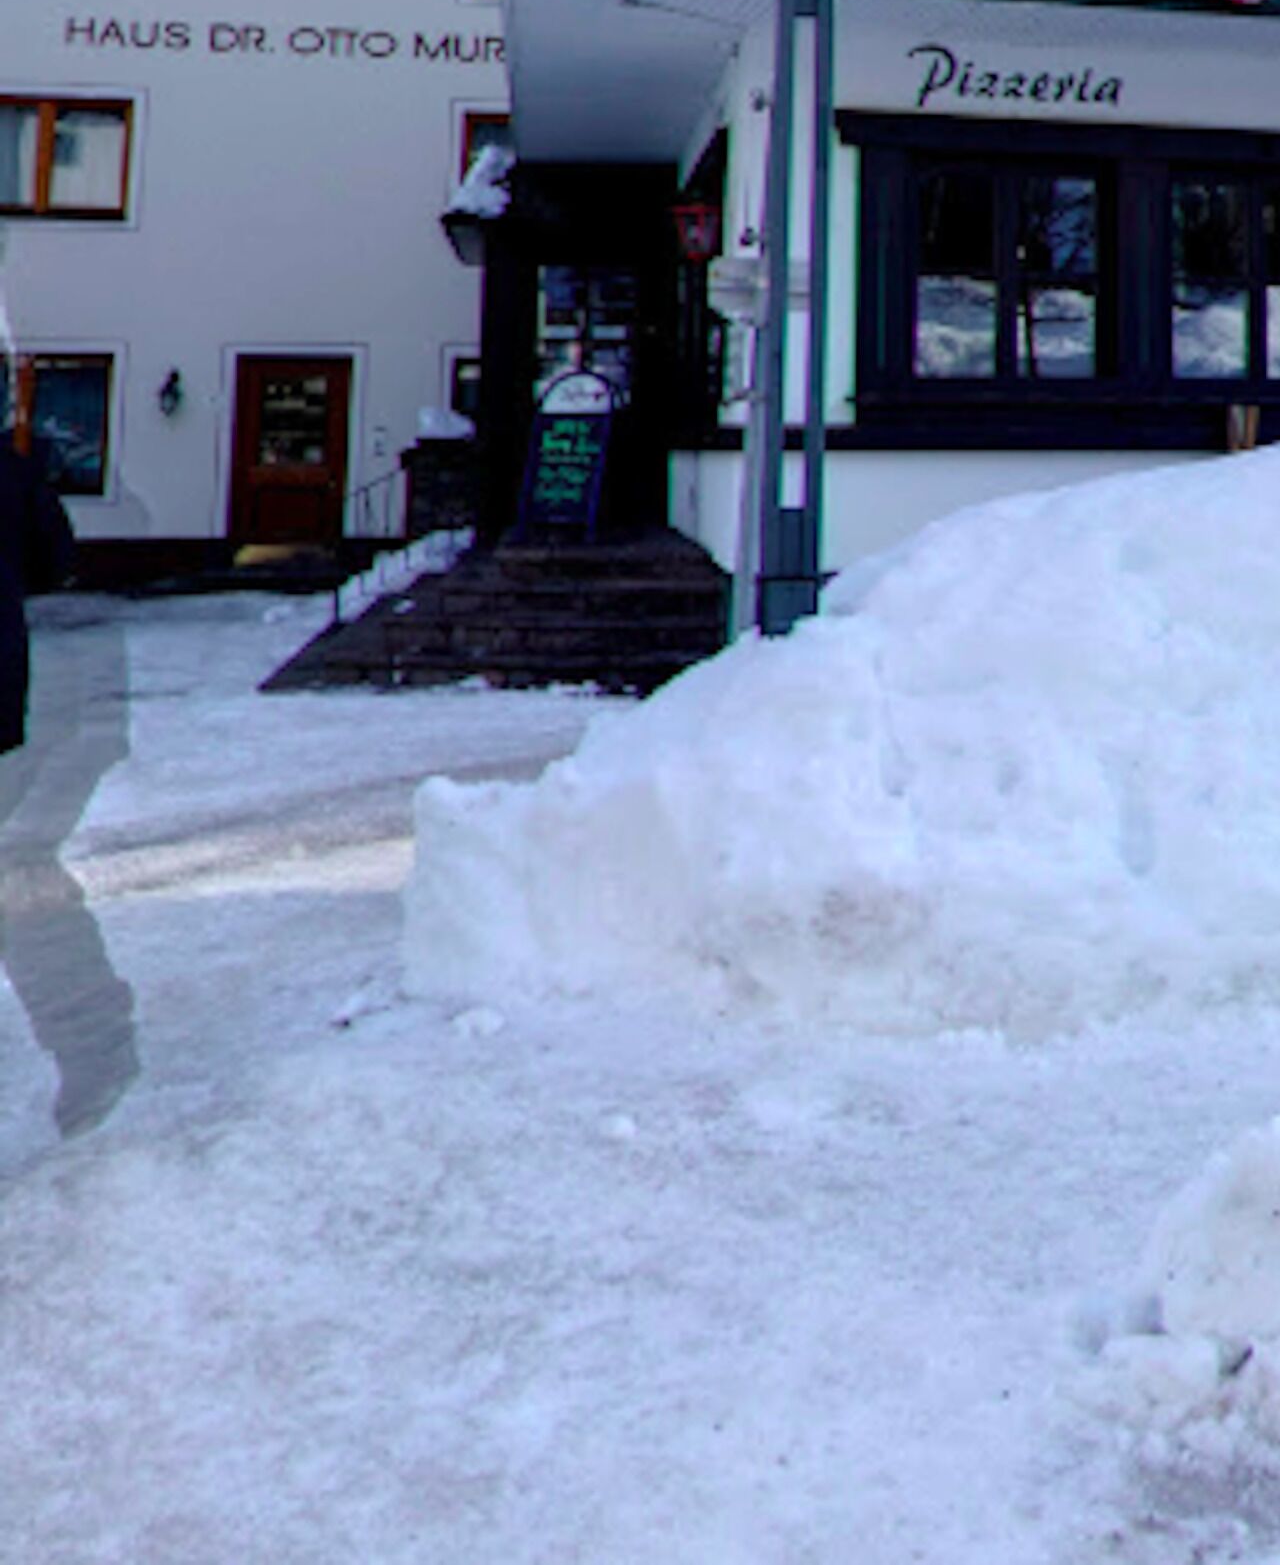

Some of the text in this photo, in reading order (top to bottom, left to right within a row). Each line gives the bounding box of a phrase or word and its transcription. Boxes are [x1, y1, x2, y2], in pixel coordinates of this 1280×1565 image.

[65, 18, 190, 49] HAUS
[209, 23, 275, 54] DR.
[288, 27, 397, 58] OTTO
[907, 44, 1125, 108] Pizzeria
